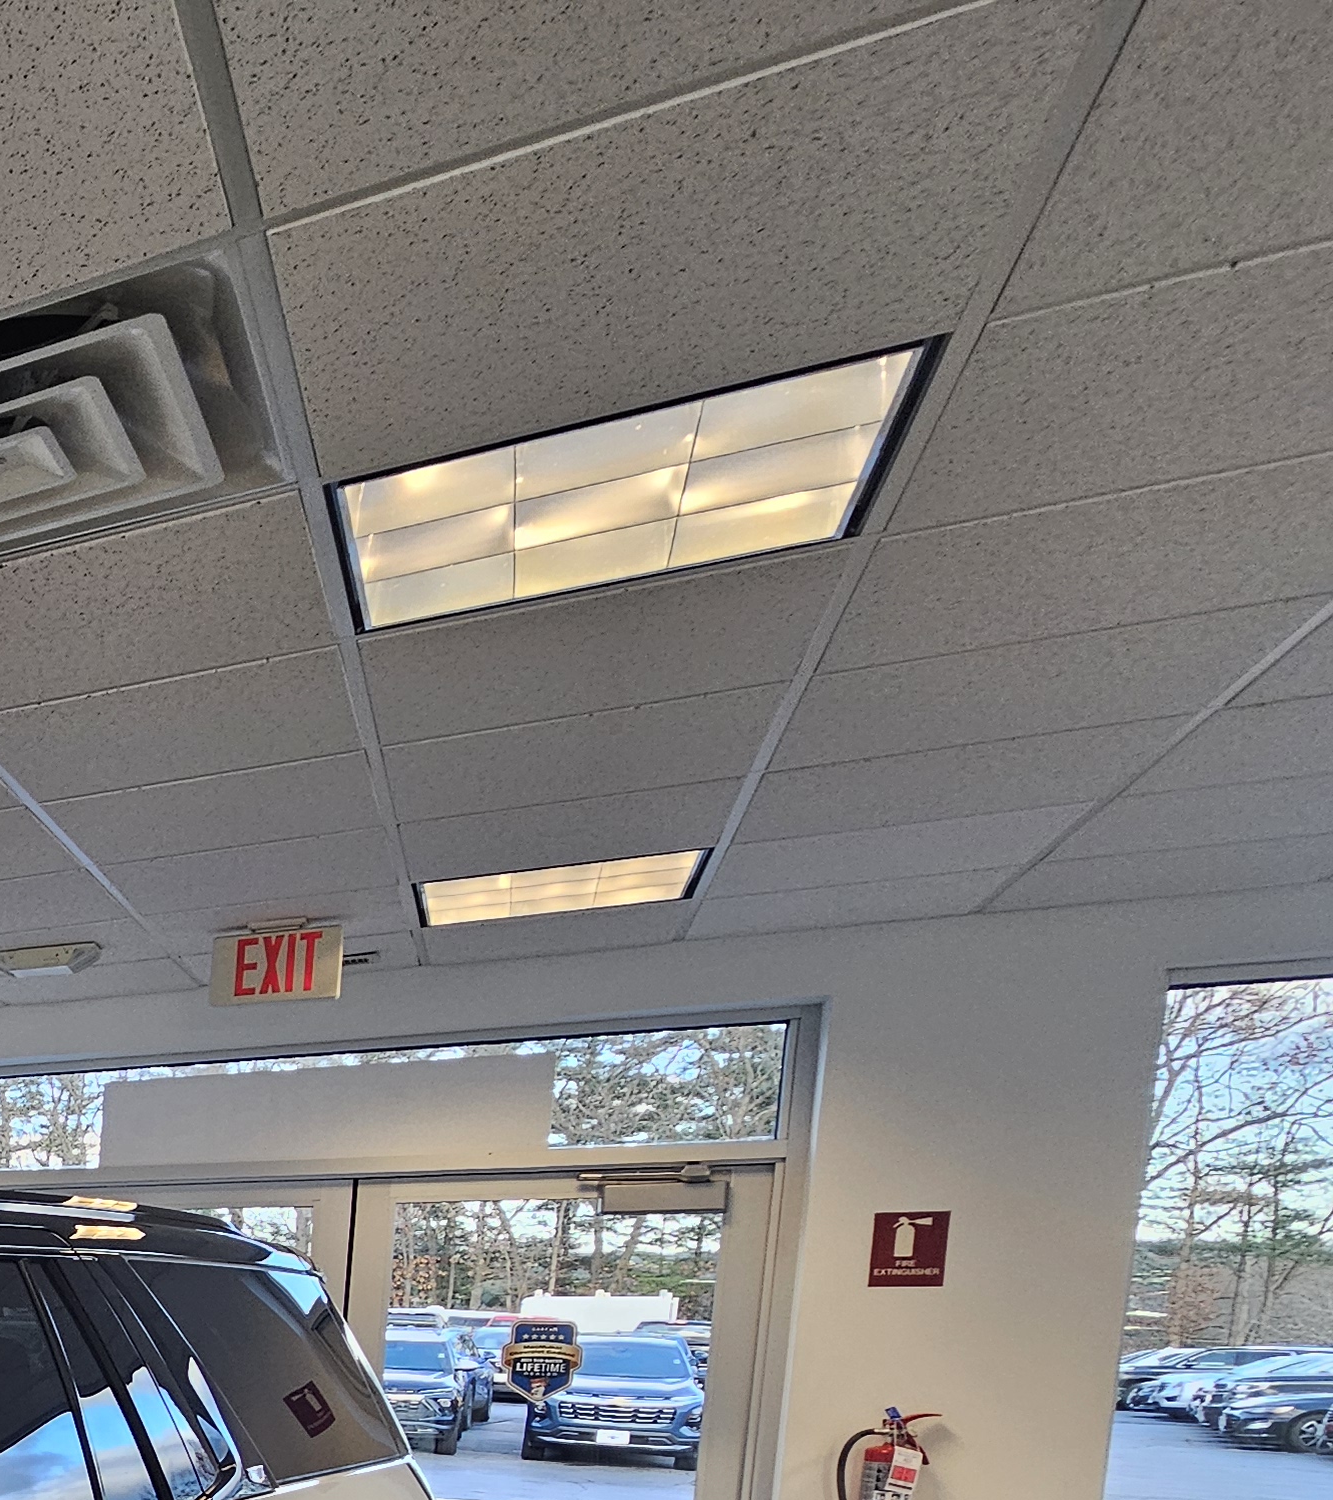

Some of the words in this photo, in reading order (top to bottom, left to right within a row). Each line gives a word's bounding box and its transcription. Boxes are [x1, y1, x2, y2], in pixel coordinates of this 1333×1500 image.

[234, 931, 323, 997] EXIT
[873, 1268, 940, 1276] EXTINGUISHER
[515, 1362, 566, 1373] LIFETIME
